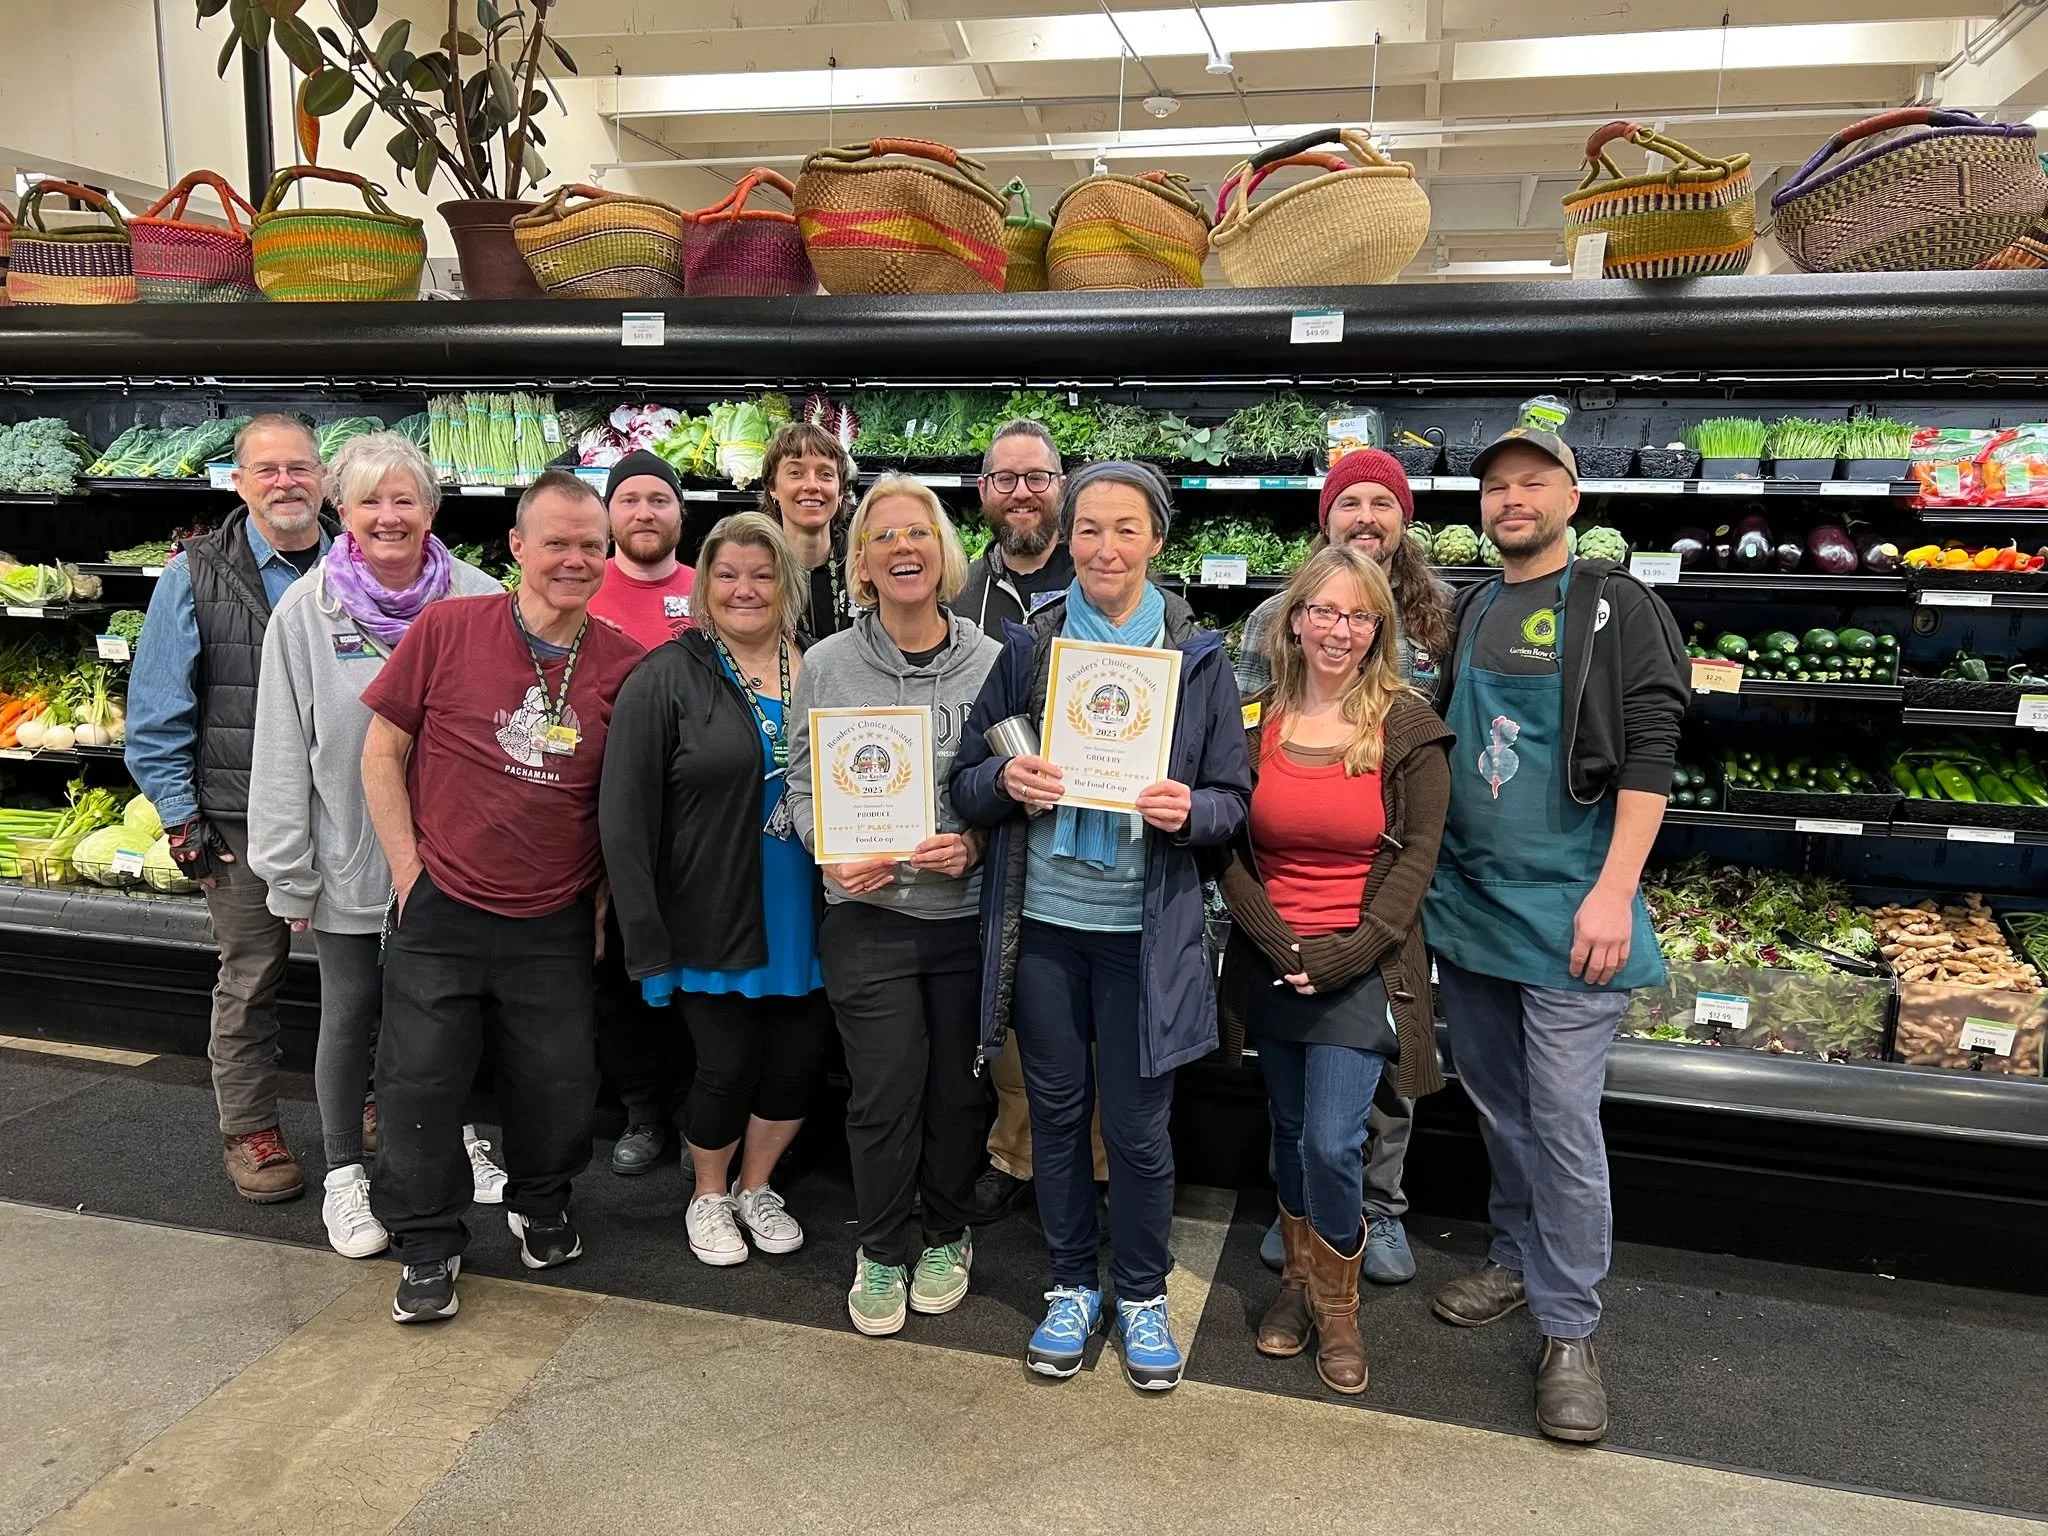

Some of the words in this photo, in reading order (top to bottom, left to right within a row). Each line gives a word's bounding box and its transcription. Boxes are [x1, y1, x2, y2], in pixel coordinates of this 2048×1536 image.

[1306, 329, 1329, 337] $49.99
[1509, 646, 1532, 656] Garden
[1533, 648, 1547, 658] Row
[1065, 659, 1099, 684] Readers'
[1101, 657, 1132, 670] Choice
[1132, 666, 1157, 693] Awards
[826, 722, 855, 749] Readers'
[857, 719, 887, 729] Choice
[887, 725, 913, 747] Awards
[1095, 728, 1117, 738] 2025
[1085, 754, 1121, 764] GROCERY
[504, 764, 560, 782] PACHAMAMA
[1095, 768, 1121, 778] PLACE
[862, 786, 883, 794] 2025
[1074, 779, 1086, 787] The
[1087, 780, 1105, 789] Food
[1106, 783, 1128, 793] Co-op
[857, 811, 890, 819] PRODUCE
[855, 836, 873, 844] Food
[1709, 1011, 1731, 1020] $12.99
[1974, 1037, 1997, 1046] $13.99
